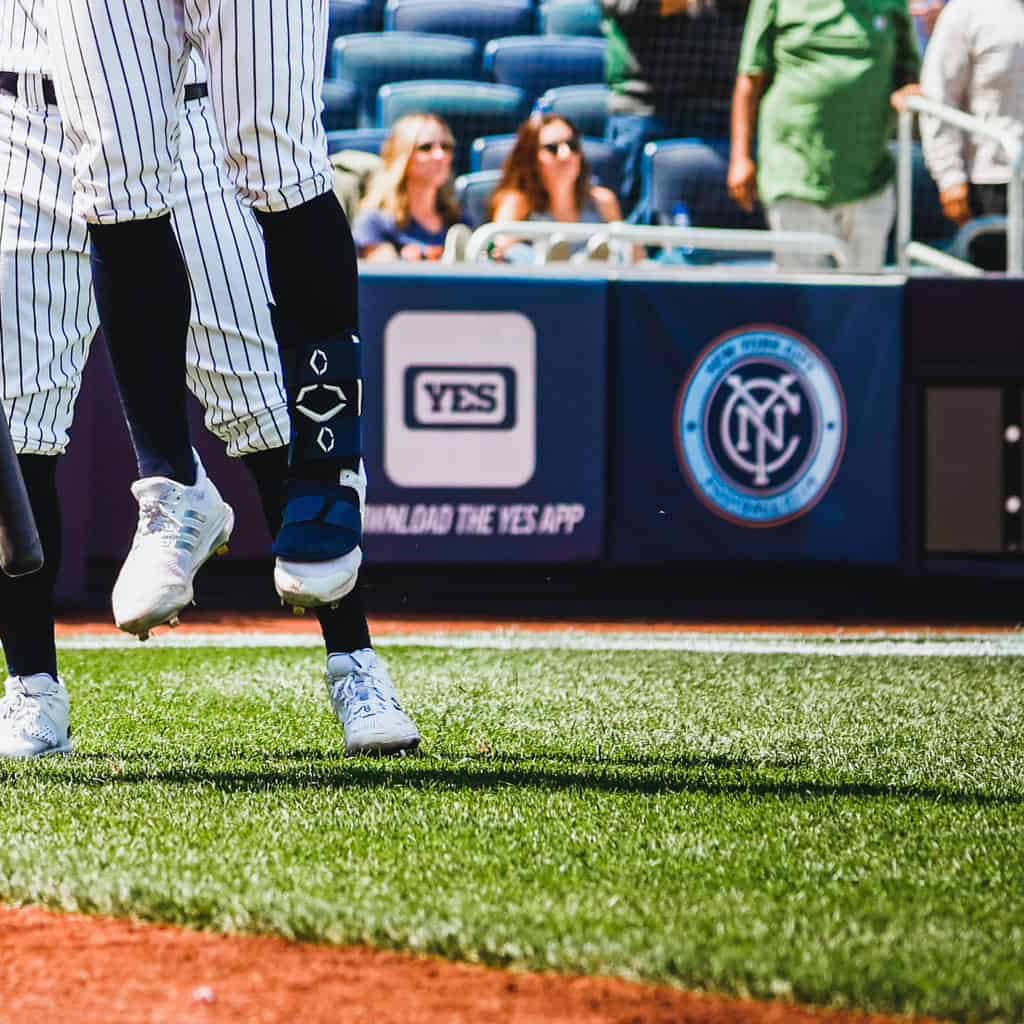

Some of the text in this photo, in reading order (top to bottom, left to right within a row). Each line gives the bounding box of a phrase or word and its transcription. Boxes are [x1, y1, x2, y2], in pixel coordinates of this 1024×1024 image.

[424, 383, 498, 413] YES
[363, 503, 585, 535] WNLOAD THE YES APP
